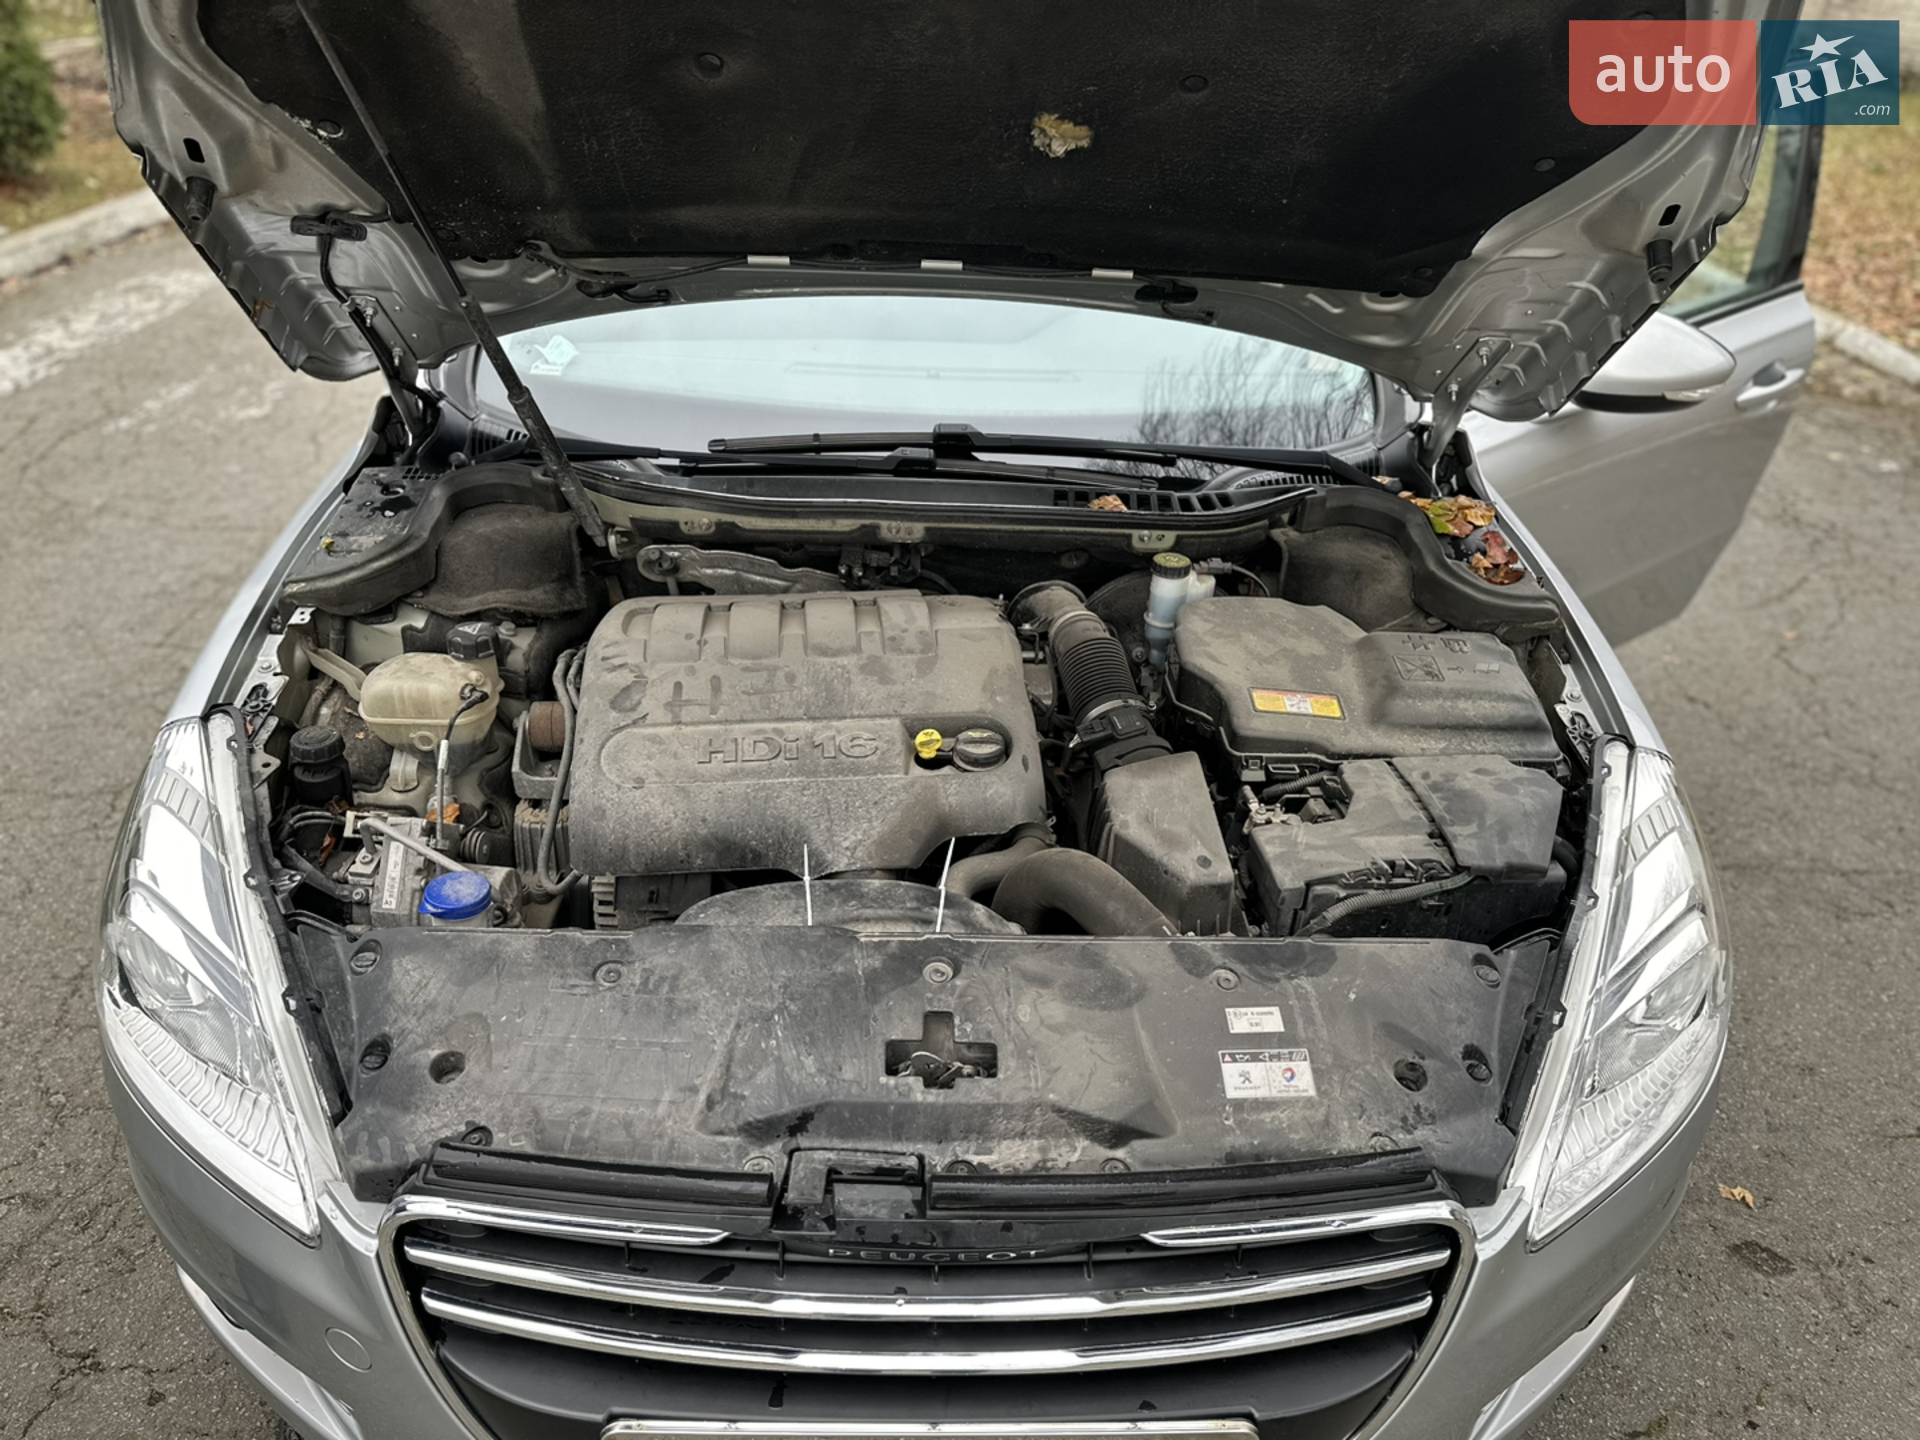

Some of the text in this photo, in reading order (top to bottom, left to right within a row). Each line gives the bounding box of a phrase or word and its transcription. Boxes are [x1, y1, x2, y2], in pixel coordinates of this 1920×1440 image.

[697, 733, 878, 765] HDi 16
[828, 1248, 1046, 1261] PEUGEOT
